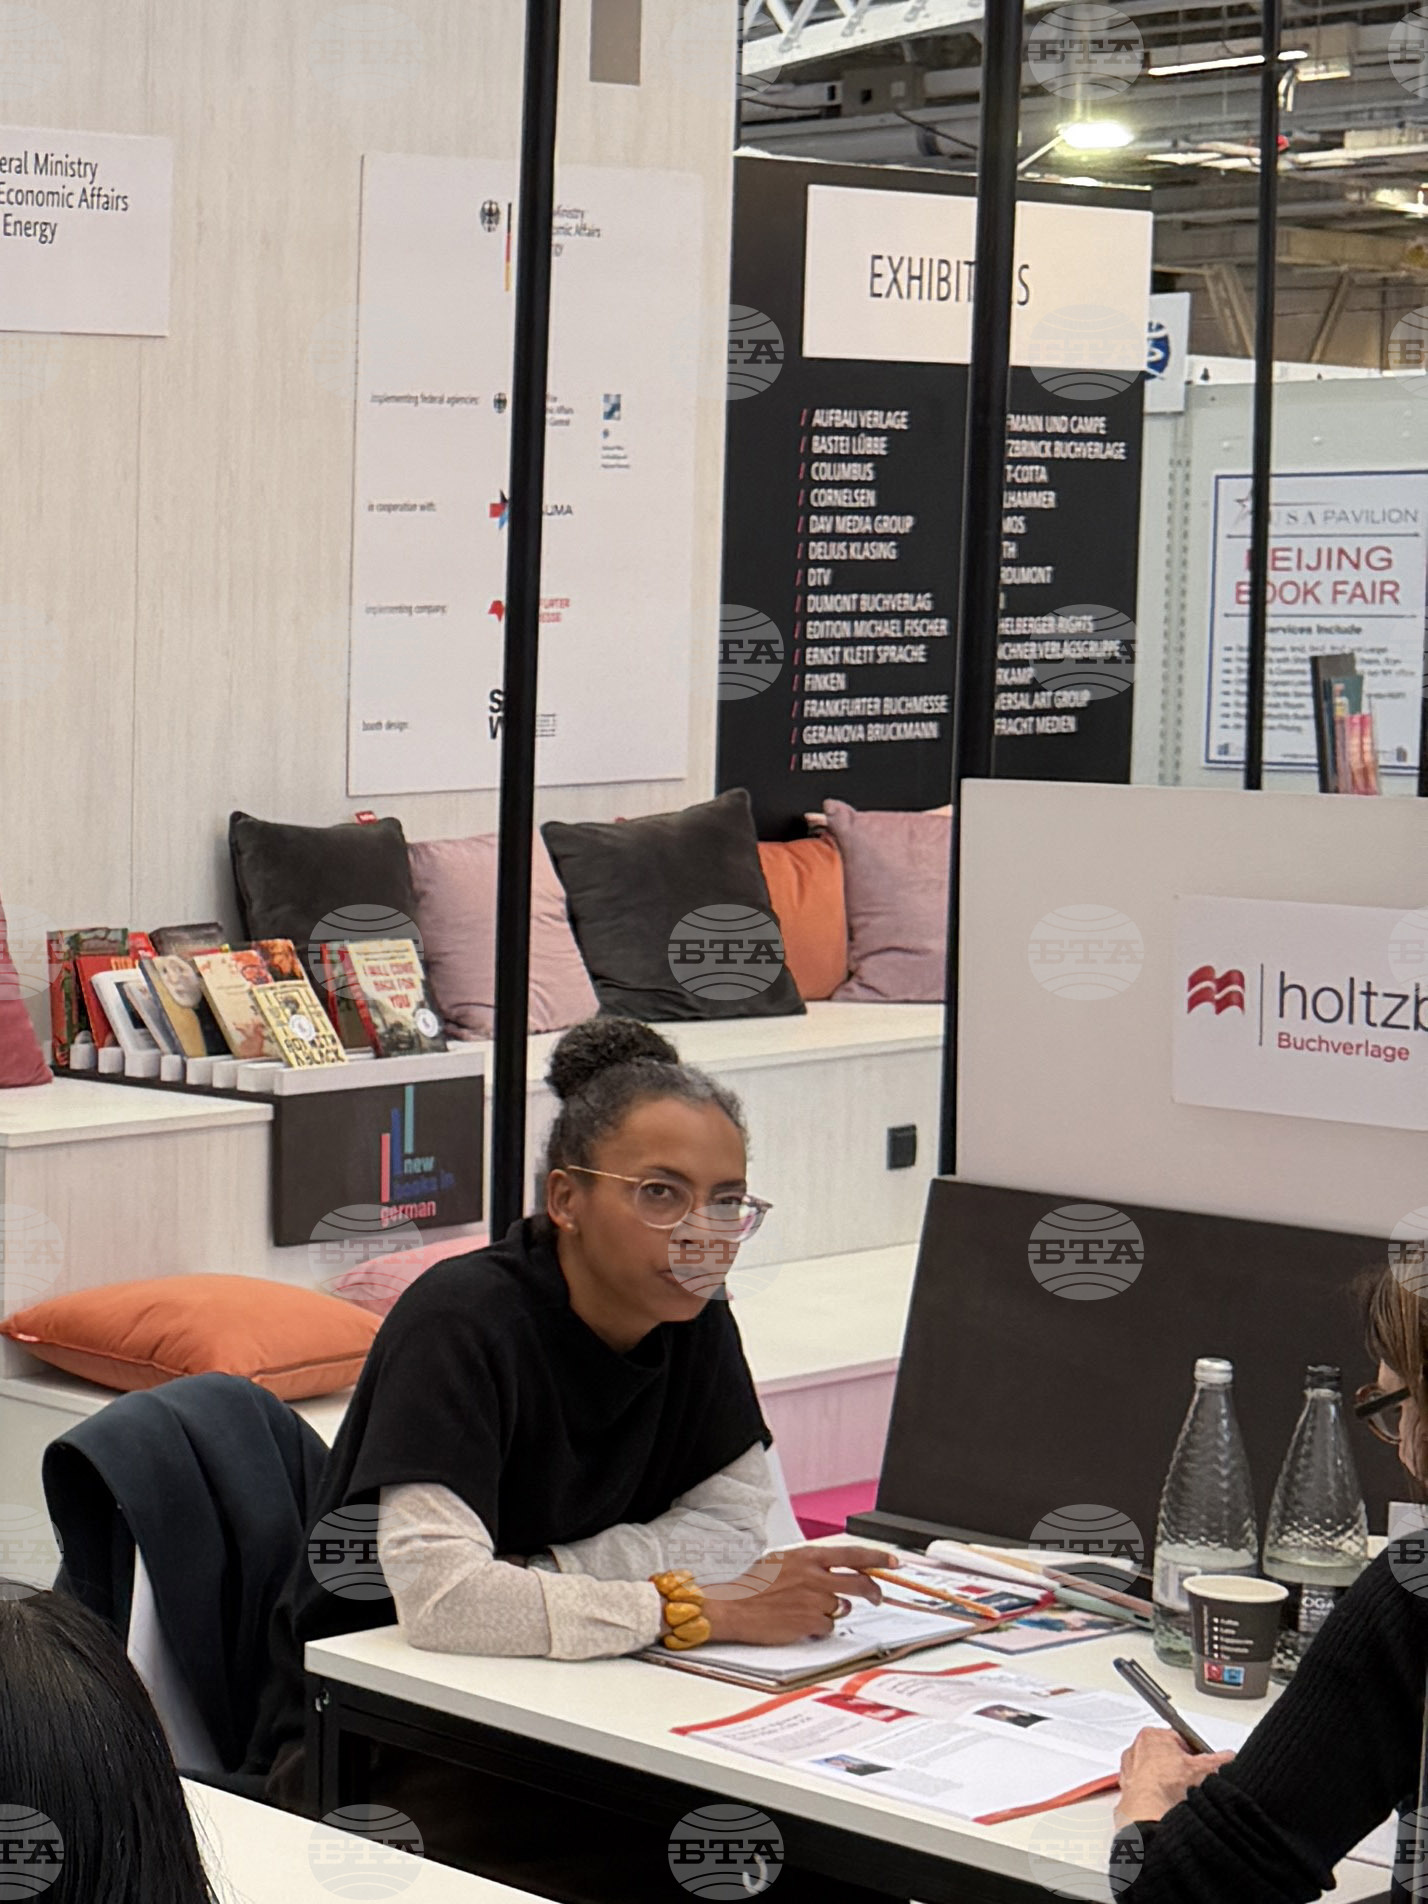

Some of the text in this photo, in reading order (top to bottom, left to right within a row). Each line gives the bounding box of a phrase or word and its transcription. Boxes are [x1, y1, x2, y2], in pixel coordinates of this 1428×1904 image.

[33, 151, 99, 185] Ministry
[77, 186, 130, 212] Affairs
[2, 213, 58, 245] Energy
[868, 253, 1031, 307] EXHIBITS
[858, 410, 910, 430] VERLAGE
[1044, 414, 1108, 435] UND CAMPE
[1053, 440, 1127, 461] BUCHVERLAGE
[810, 461, 875, 481] COLUMBUS
[810, 488, 876, 507] CORNELSEN
[834, 515, 873, 534] MEDIA
[874, 514, 916, 534] GROUP
[1322, 507, 1420, 525] PAVILION
[807, 568, 833, 586] DTV
[806, 592, 934, 613] DUMONT BUCHVERLAG
[1330, 579, 1402, 606] FAIR
[805, 617, 950, 640] EDITION MICHAEL FISCHER
[1265, 623, 1313, 635] ervices
[805, 643, 928, 666] ERNST KLETT SPRACHE
[804, 672, 848, 692] FINKEN
[803, 694, 950, 718] FRANKFURTER BUCHMESSE
[1053, 689, 1092, 709] GROUP
[866, 721, 940, 742] BRUCKMANN
[1035, 714, 1078, 735] MEDIEN
[801, 750, 849, 771] HANSER
[1276, 1031, 1411, 1063] Buchverlage
[403, 1155, 436, 1175] new
[380, 1200, 437, 1229] german
